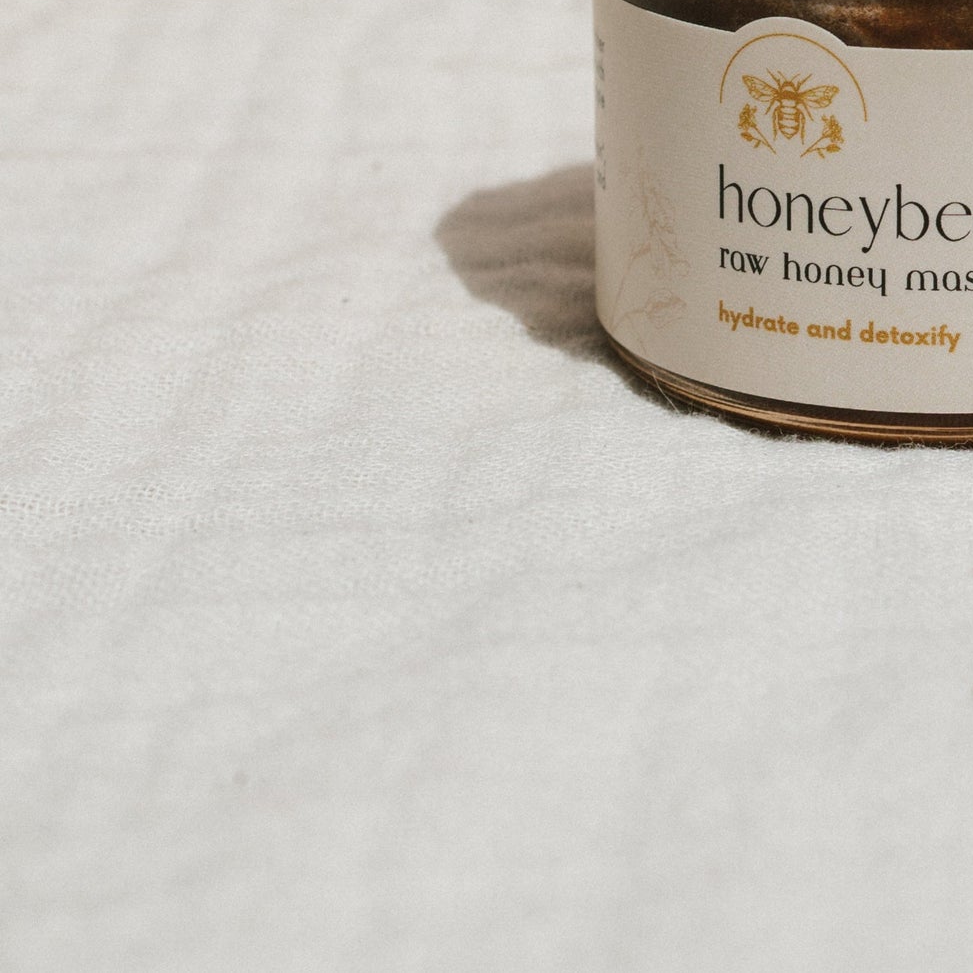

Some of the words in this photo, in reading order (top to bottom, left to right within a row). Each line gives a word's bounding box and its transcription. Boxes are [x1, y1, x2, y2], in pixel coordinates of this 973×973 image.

[719, 246, 770, 276] raw
[782, 252, 888, 297] honey
[718, 300, 800, 335] hydrate
[807, 319, 852, 342] and
[859, 321, 962, 353] detoxify
